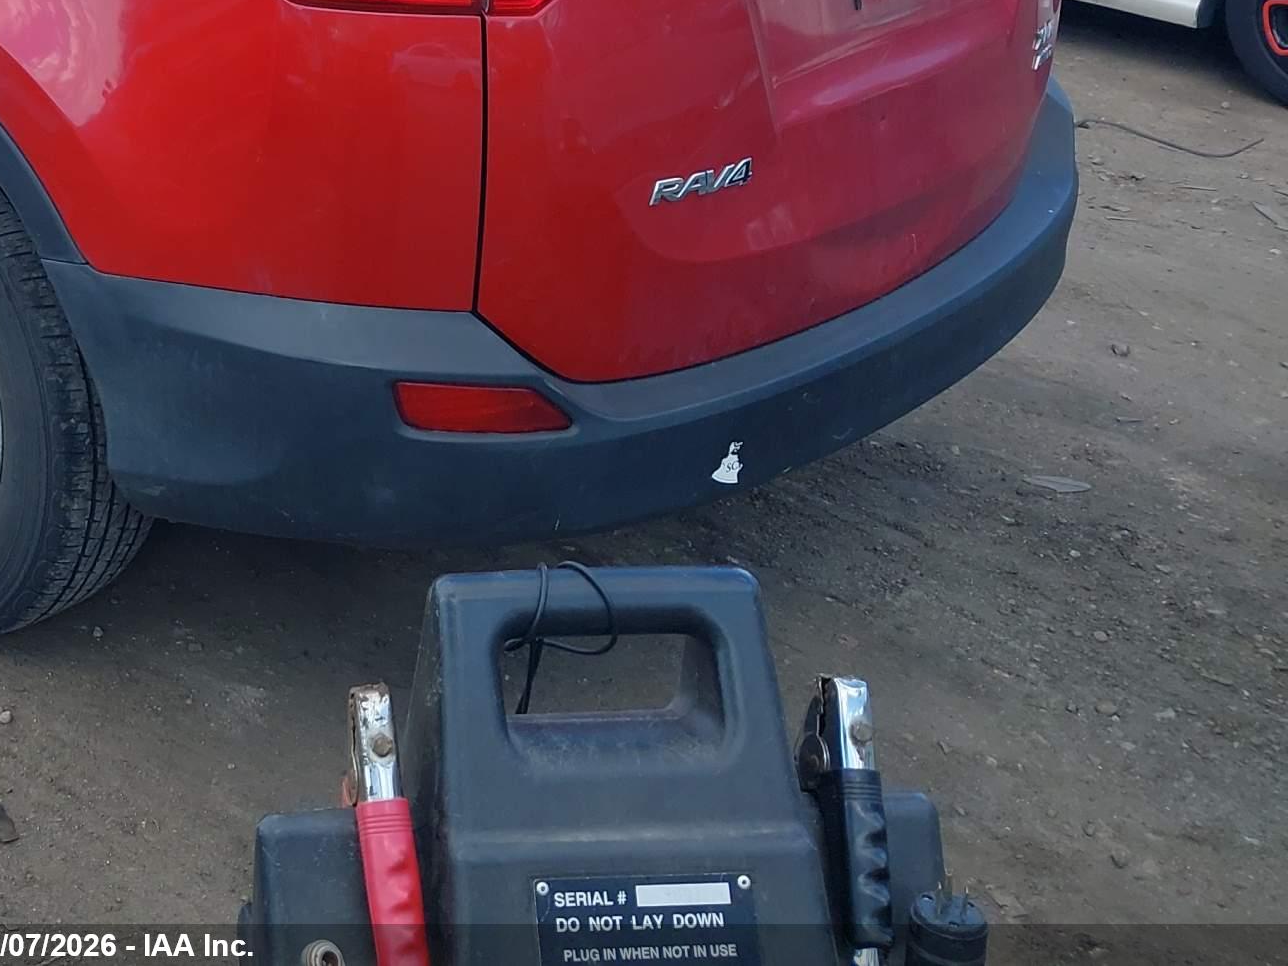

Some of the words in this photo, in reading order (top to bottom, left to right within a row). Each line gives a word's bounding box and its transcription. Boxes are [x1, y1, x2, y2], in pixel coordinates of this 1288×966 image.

[649, 157, 752, 205] RAV4
[554, 891, 613, 907] SERIAL
[617, 890, 627, 905] #
[556, 917, 580, 932] DO
[589, 915, 623, 931] NOT
[632, 914, 664, 930] LAY
[673, 912, 725, 928] DOWN
[564, 948, 600, 962] PLUG
[604, 948, 617, 961] IN
[619, 946, 660, 960] WHEN
[662, 945, 691, 959] NOT
[694, 945, 708, 957] IN
[711, 944, 737, 957] USE
